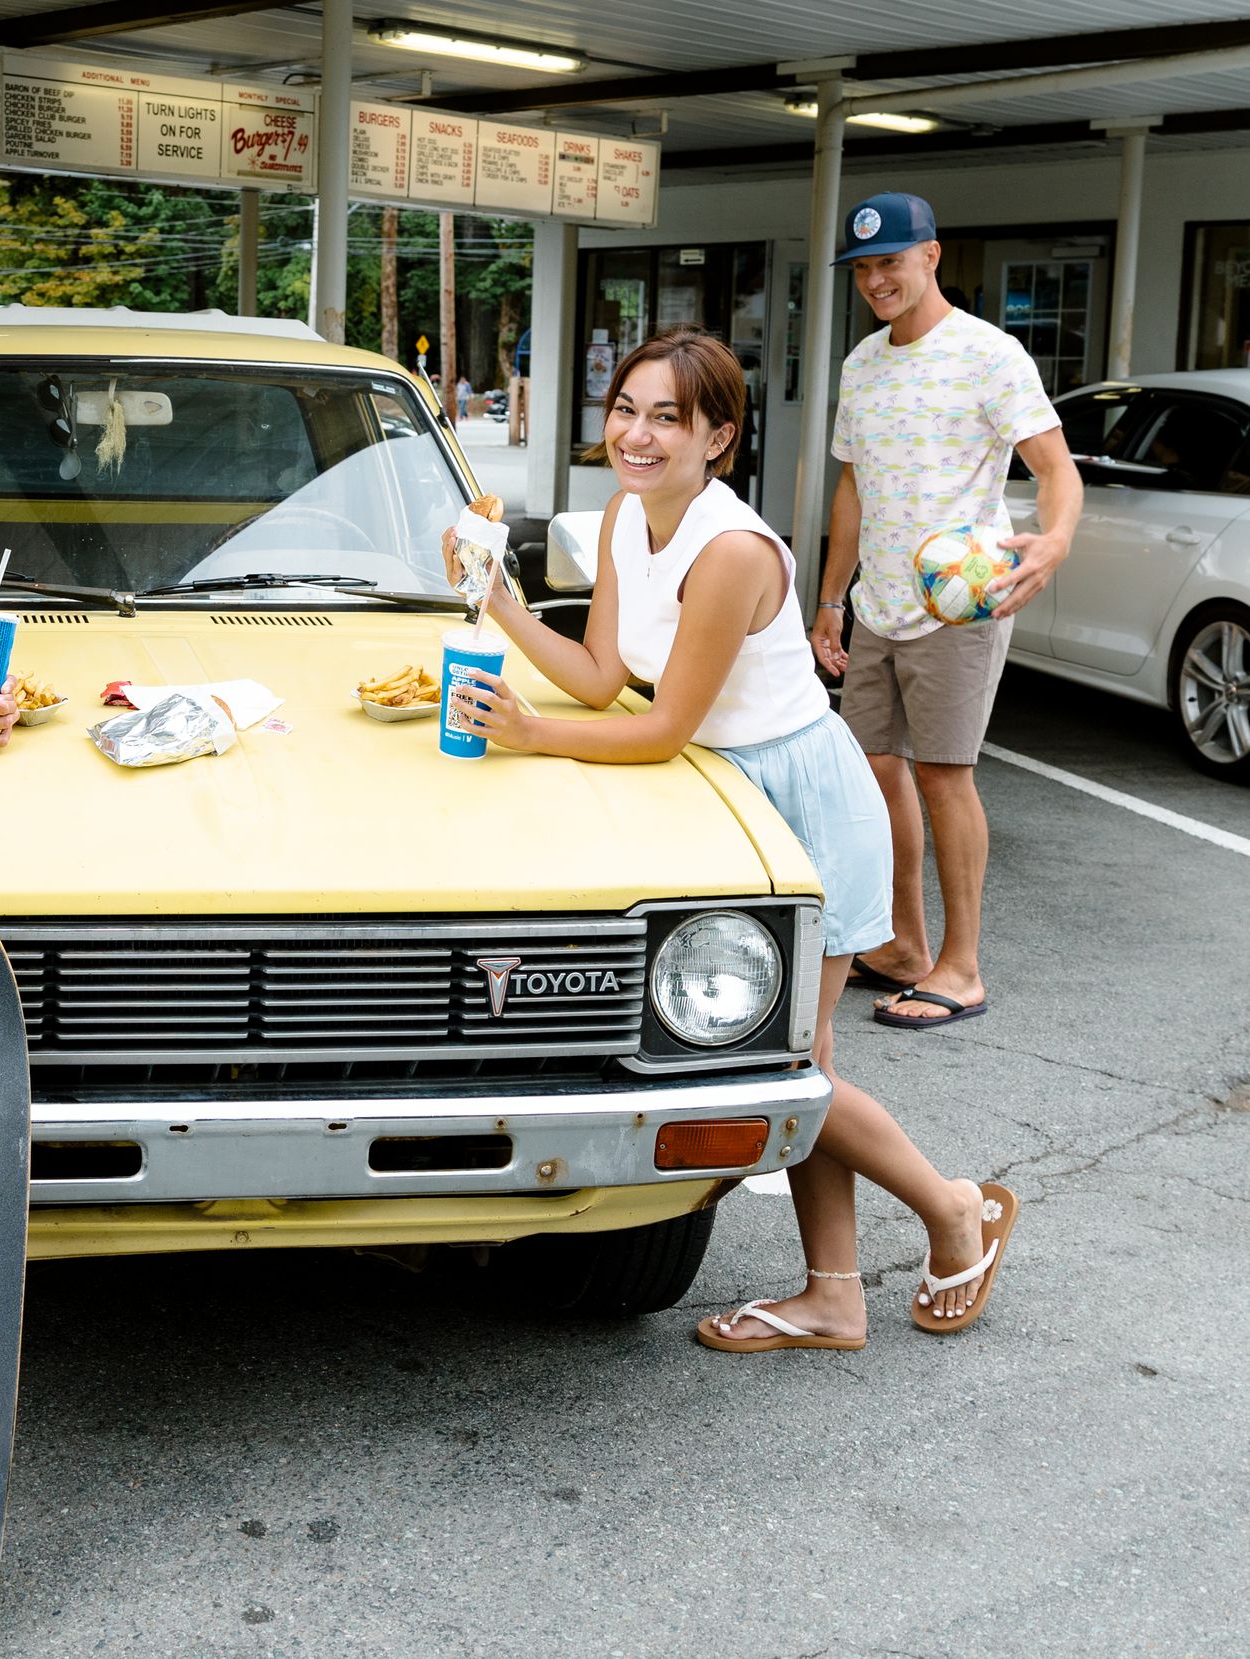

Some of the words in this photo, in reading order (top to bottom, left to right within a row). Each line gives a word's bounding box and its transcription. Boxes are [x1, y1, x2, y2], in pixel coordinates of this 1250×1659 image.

[82, 71, 124, 84] ADDITIONAL
[130, 78, 150, 87] MENU
[5, 83, 29, 92] BARON
[31, 86, 41, 94] OF
[43, 88, 61, 97] BEEF
[38, 96, 62, 106] STRIPS
[238, 91, 268, 102] MONTHLY
[275, 96, 300, 106] SPECIAL
[38, 104, 66, 114] BURGER
[145, 102, 175, 118] TURN
[177, 106, 216, 122] LIGHTS
[38, 112, 56, 121] CLUB
[58, 114, 87, 124] BURGER
[264, 114, 297, 130] CHEESE
[358, 111, 400, 128] BURGERS
[65, 131, 92, 141] BURGER
[160, 124, 176, 138] ON
[179, 125, 201, 139] FOR
[429, 121, 463, 138] SNACKS
[231, 128, 282, 158] Burger
[496, 131, 540, 149] SEAFOODS
[563, 140, 591, 156] DRINKS
[157, 143, 203, 160] SERVICE
[614, 148, 643, 163] SHAKES
[510, 971, 620, 995] TOYOTA
